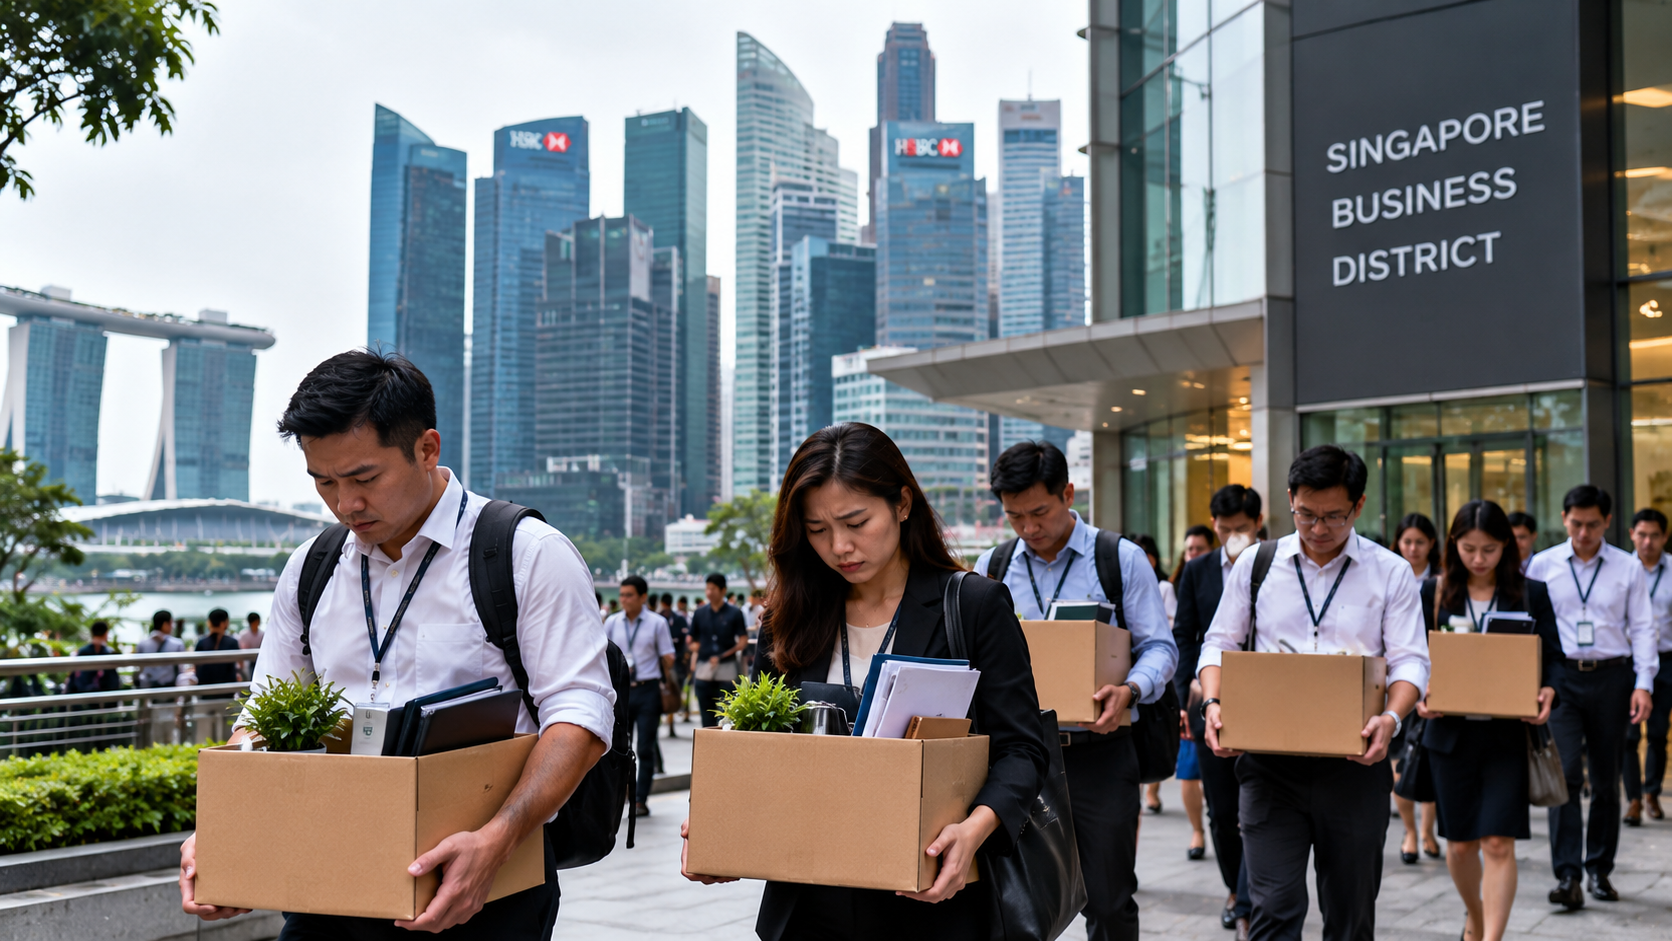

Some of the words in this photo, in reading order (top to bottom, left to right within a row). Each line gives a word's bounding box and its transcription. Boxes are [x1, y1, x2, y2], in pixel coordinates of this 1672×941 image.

[1326, 100, 1545, 173] SINGAPORE
[1332, 167, 1517, 229] BUSINESS
[1333, 231, 1501, 287] DISTRICT
